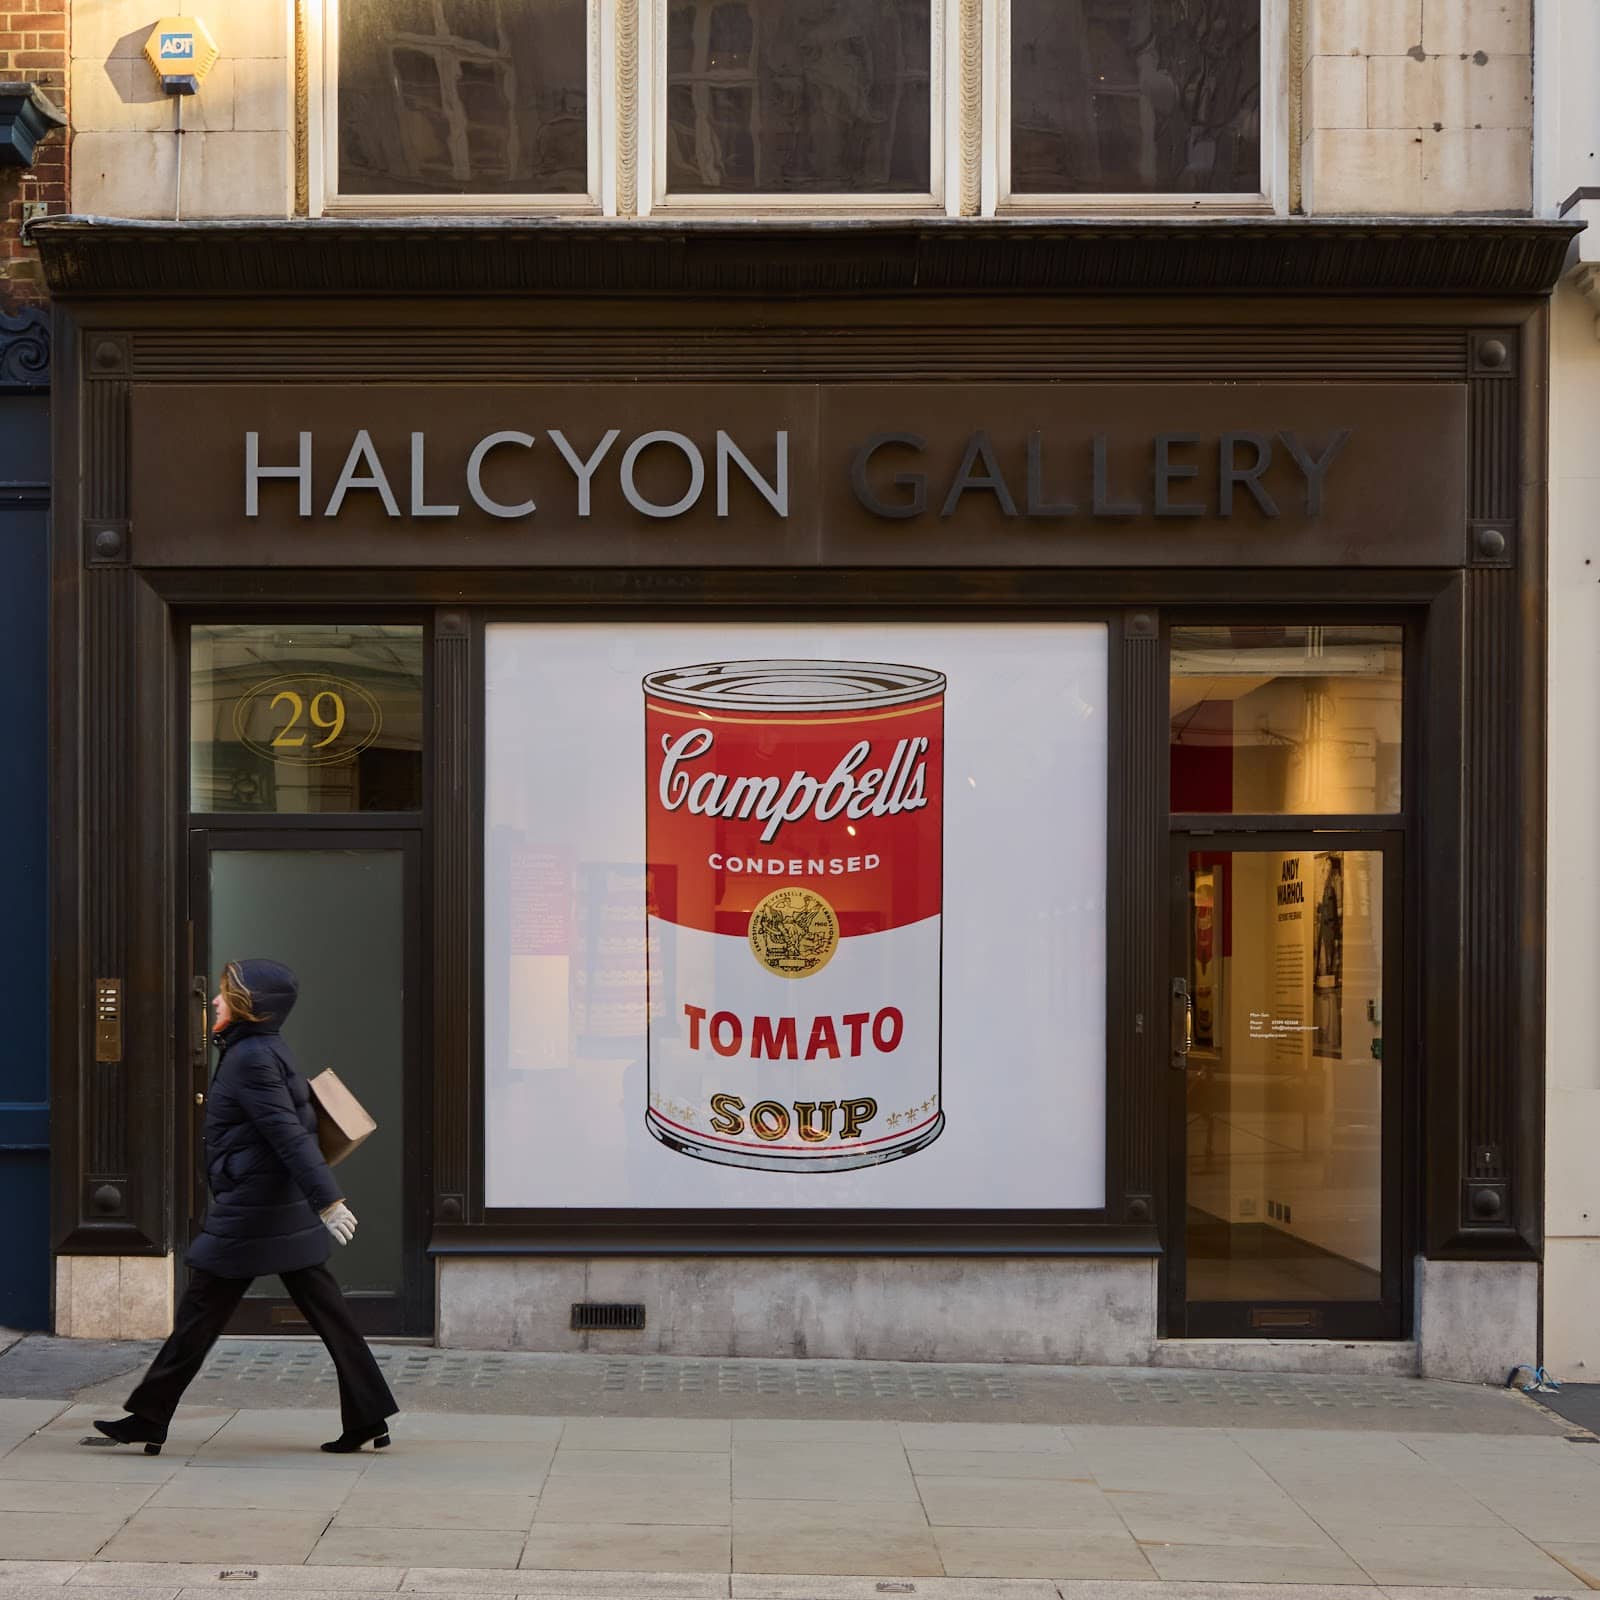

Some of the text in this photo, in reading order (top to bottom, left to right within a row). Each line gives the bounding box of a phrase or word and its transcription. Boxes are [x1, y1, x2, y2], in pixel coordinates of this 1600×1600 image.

[161, 37, 193, 54] ADT
[245, 429, 1352, 519] HALCYON GALLERY
[270, 691, 346, 748] 29
[660, 728, 929, 844] Campbell's
[708, 853, 881, 876] CONDENSED
[1281, 857, 1300, 882] ANDY
[1277, 880, 1305, 906] WARHOL
[684, 1003, 904, 1060] TOMATO
[709, 1093, 878, 1142] SOUP
